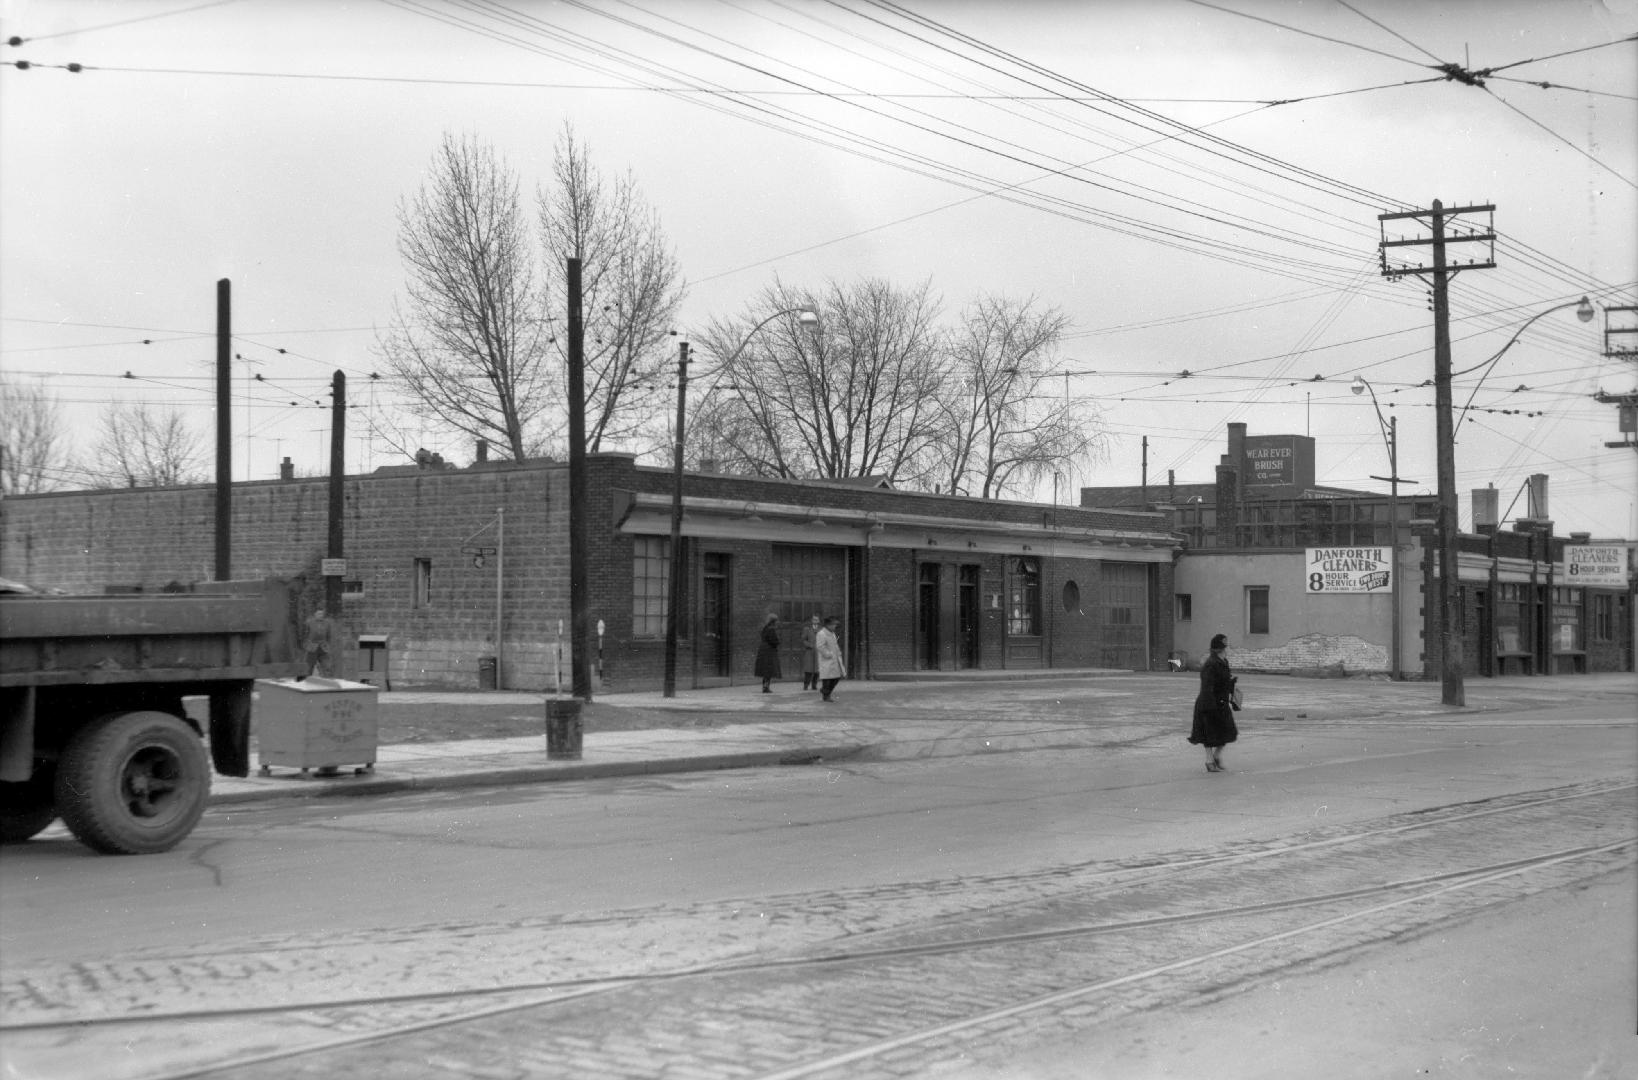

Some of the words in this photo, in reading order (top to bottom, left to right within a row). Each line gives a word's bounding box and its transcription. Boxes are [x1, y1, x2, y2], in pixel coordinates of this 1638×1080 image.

[1255, 460, 1284, 470] BRUSH
[1313, 549, 1384, 562] DANFORTH
[1323, 559, 1377, 571] CLEANERS
[1569, 563, 1579, 575] 8
[1310, 572, 1324, 591] 8
[1325, 572, 1349, 580] HOUR
[1325, 579, 1357, 587] SERVICE
